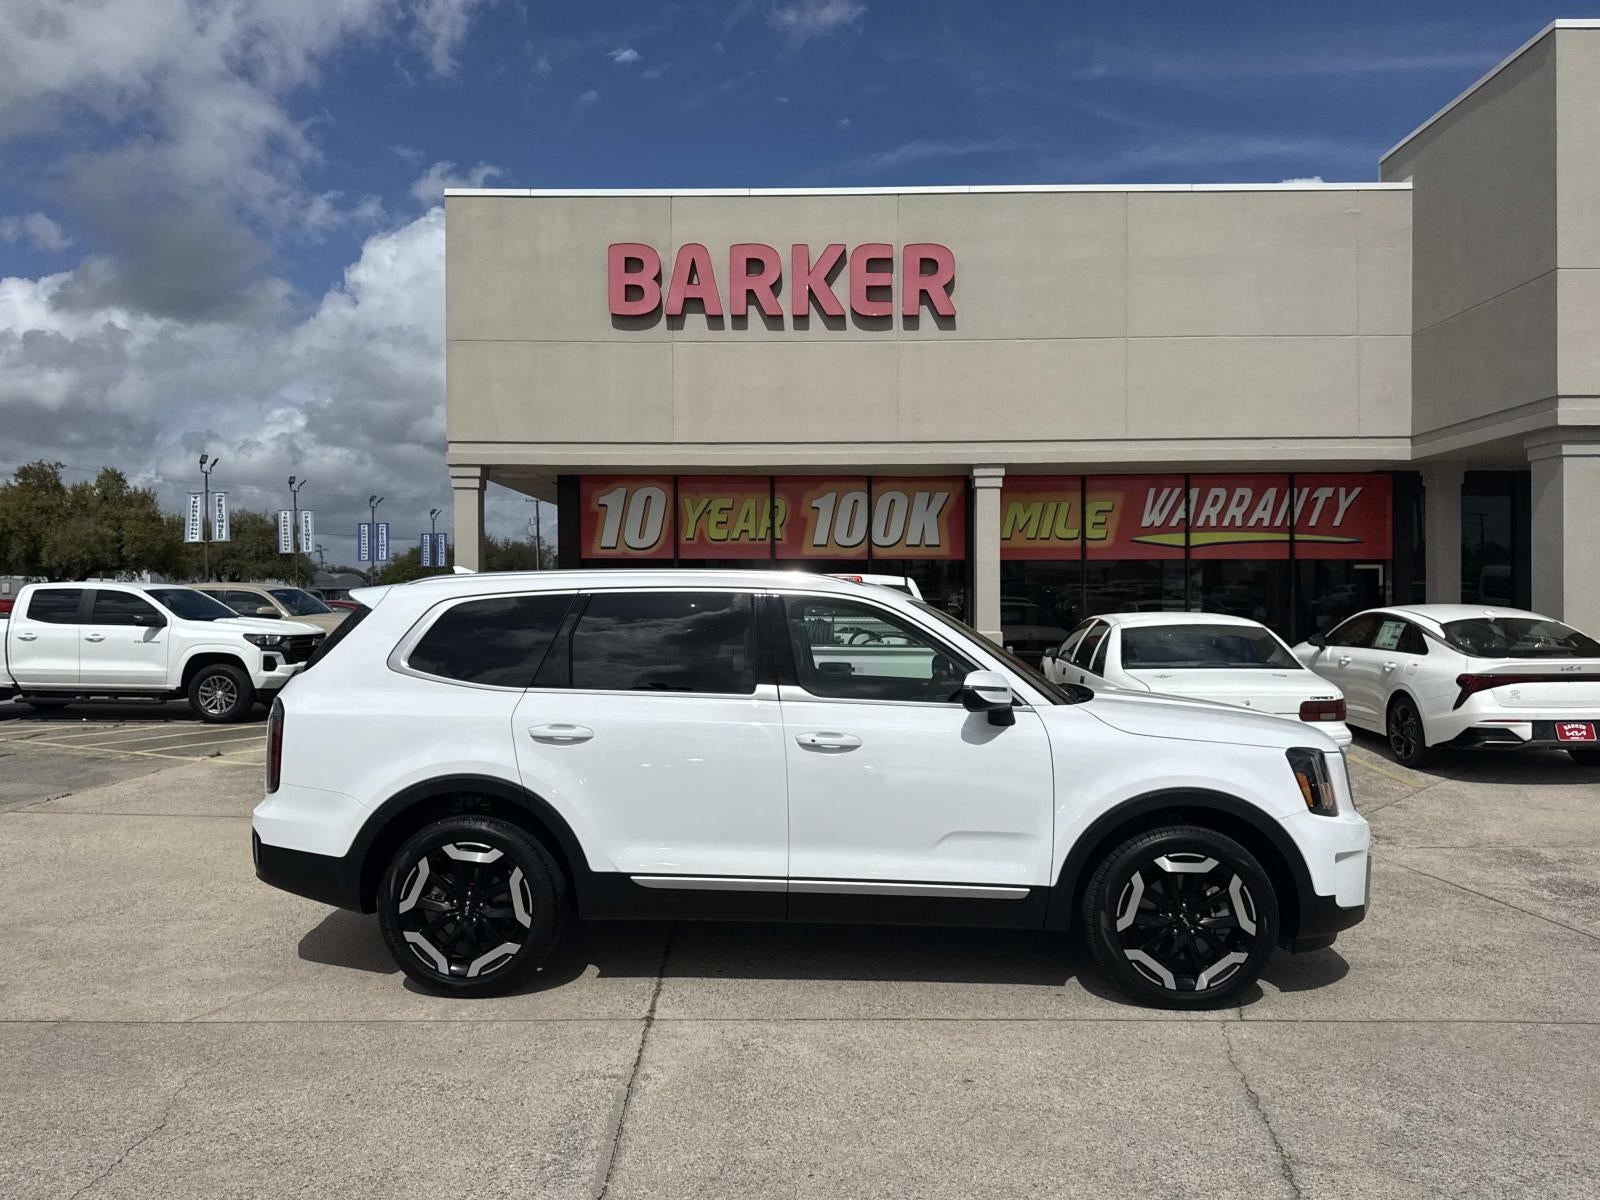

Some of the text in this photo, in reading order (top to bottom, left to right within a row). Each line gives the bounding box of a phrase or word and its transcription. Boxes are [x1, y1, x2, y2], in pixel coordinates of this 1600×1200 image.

[608, 242, 957, 318] BARKER
[598, 486, 1363, 551] 10 YEAR 100K MILE WARRANTY
